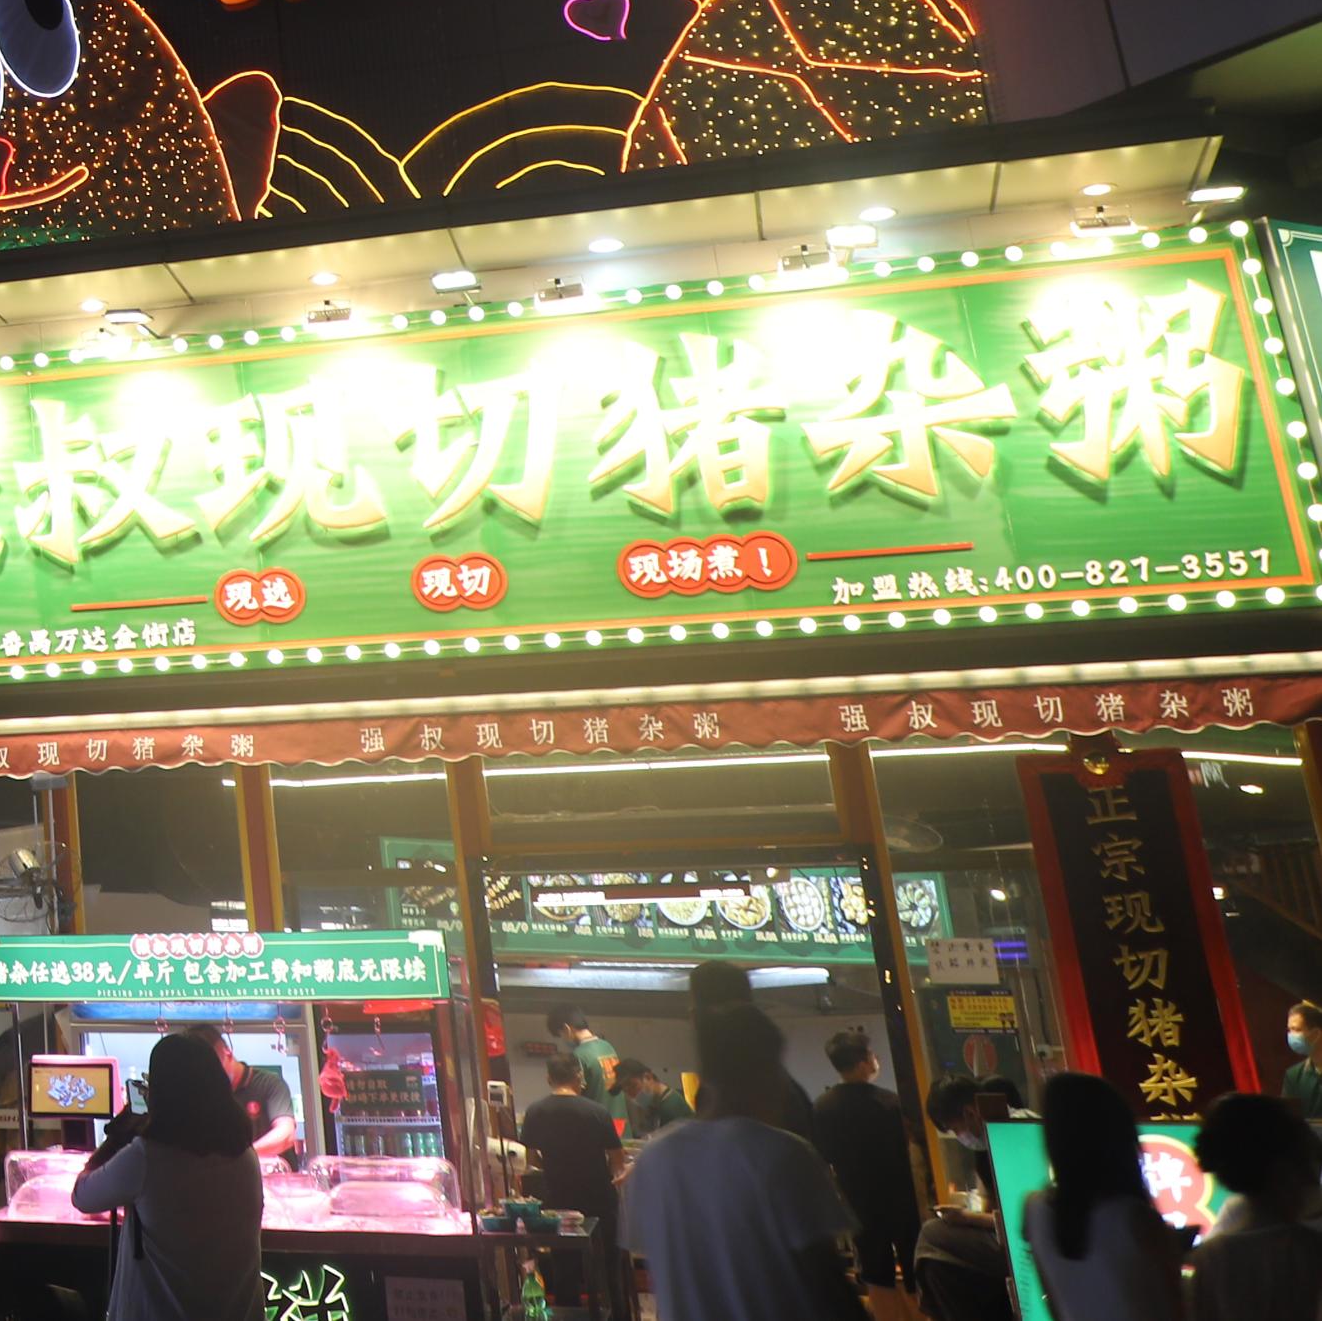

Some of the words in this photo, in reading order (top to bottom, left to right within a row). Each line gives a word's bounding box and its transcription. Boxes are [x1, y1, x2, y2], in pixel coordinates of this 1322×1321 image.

[223, 577, 296, 613] 现选
[422, 564, 491, 599] 现切
[839, 687, 1254, 733] 强叔现切猪杂粥
[361, 711, 721, 755] 强叔现切猪杂粥
[1085, 784, 1203, 1121] 正宗现切猪杂
